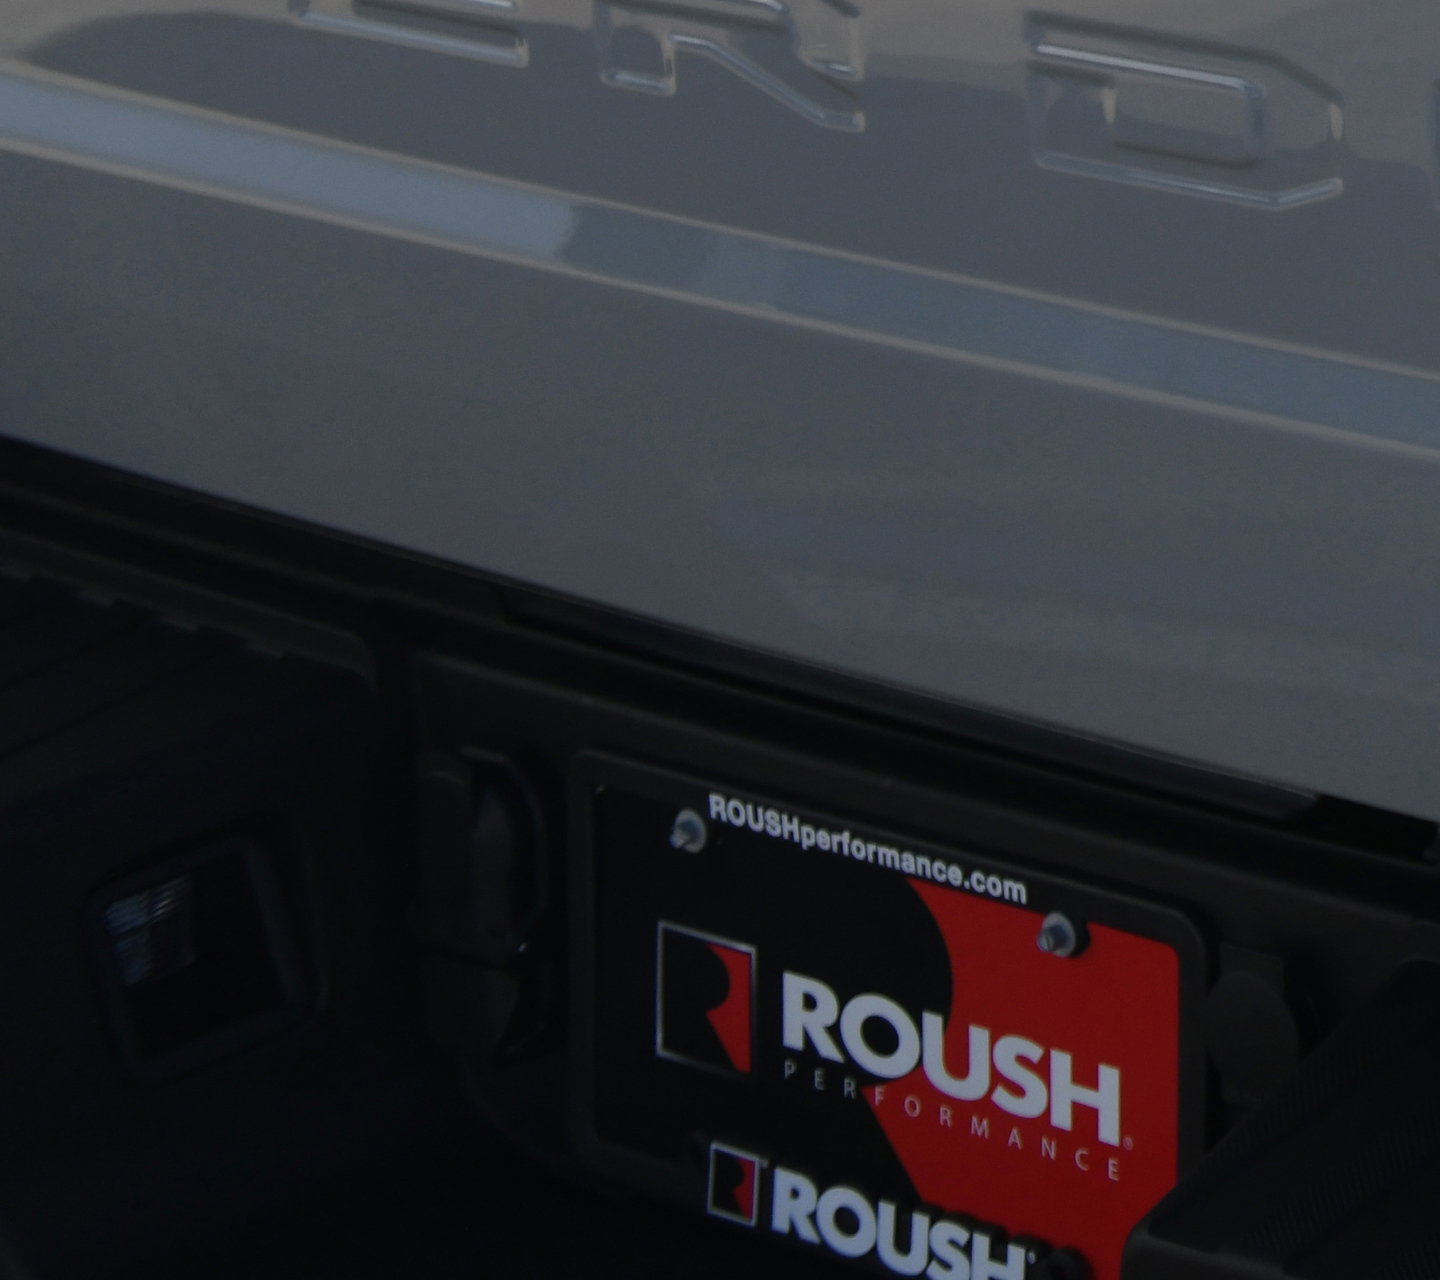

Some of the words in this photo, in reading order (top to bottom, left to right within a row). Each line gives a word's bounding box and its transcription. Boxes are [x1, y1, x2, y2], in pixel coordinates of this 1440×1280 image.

[708, 792, 1028, 906] ROUSHperformance.com
[781, 971, 1121, 1147] ROUSH
[784, 1059, 1121, 1183] PERFORMANCE
[772, 1166, 1027, 1280] ROUSH
